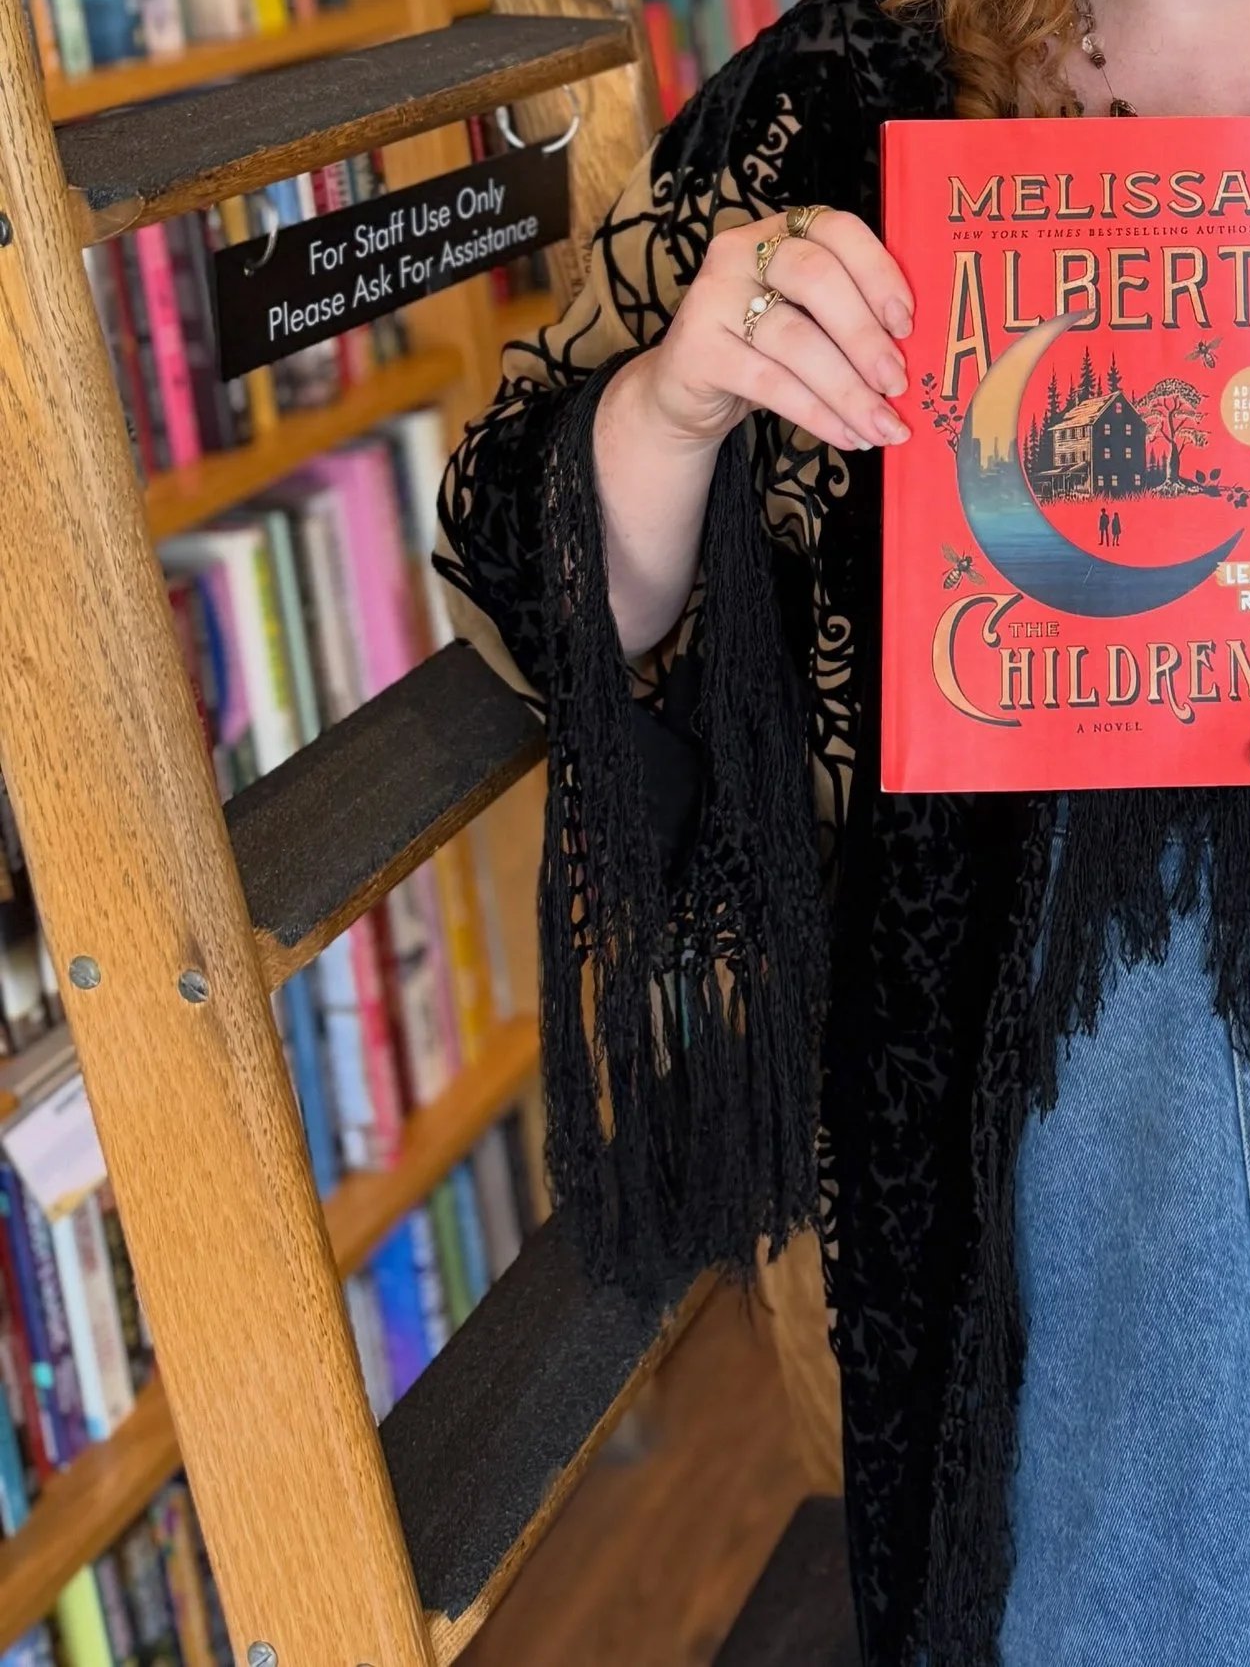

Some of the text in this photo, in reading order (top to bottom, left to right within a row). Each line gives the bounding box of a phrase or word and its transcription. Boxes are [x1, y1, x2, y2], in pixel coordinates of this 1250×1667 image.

[308, 177, 505, 276] For Staff Use Only
[952, 230, 984, 241] NEW
[991, 229, 1029, 239] YORK
[1037, 228, 1082, 238] TIMES
[1088, 226, 1189, 237] BESTSELLING
[267, 291, 346, 342] Please
[352, 264, 393, 309] Ask
[399, 255, 434, 289] For
[439, 215, 539, 273] Assistance
[1007, 621, 1060, 639] THE
[1076, 721, 1143, 734] A NOVEL
